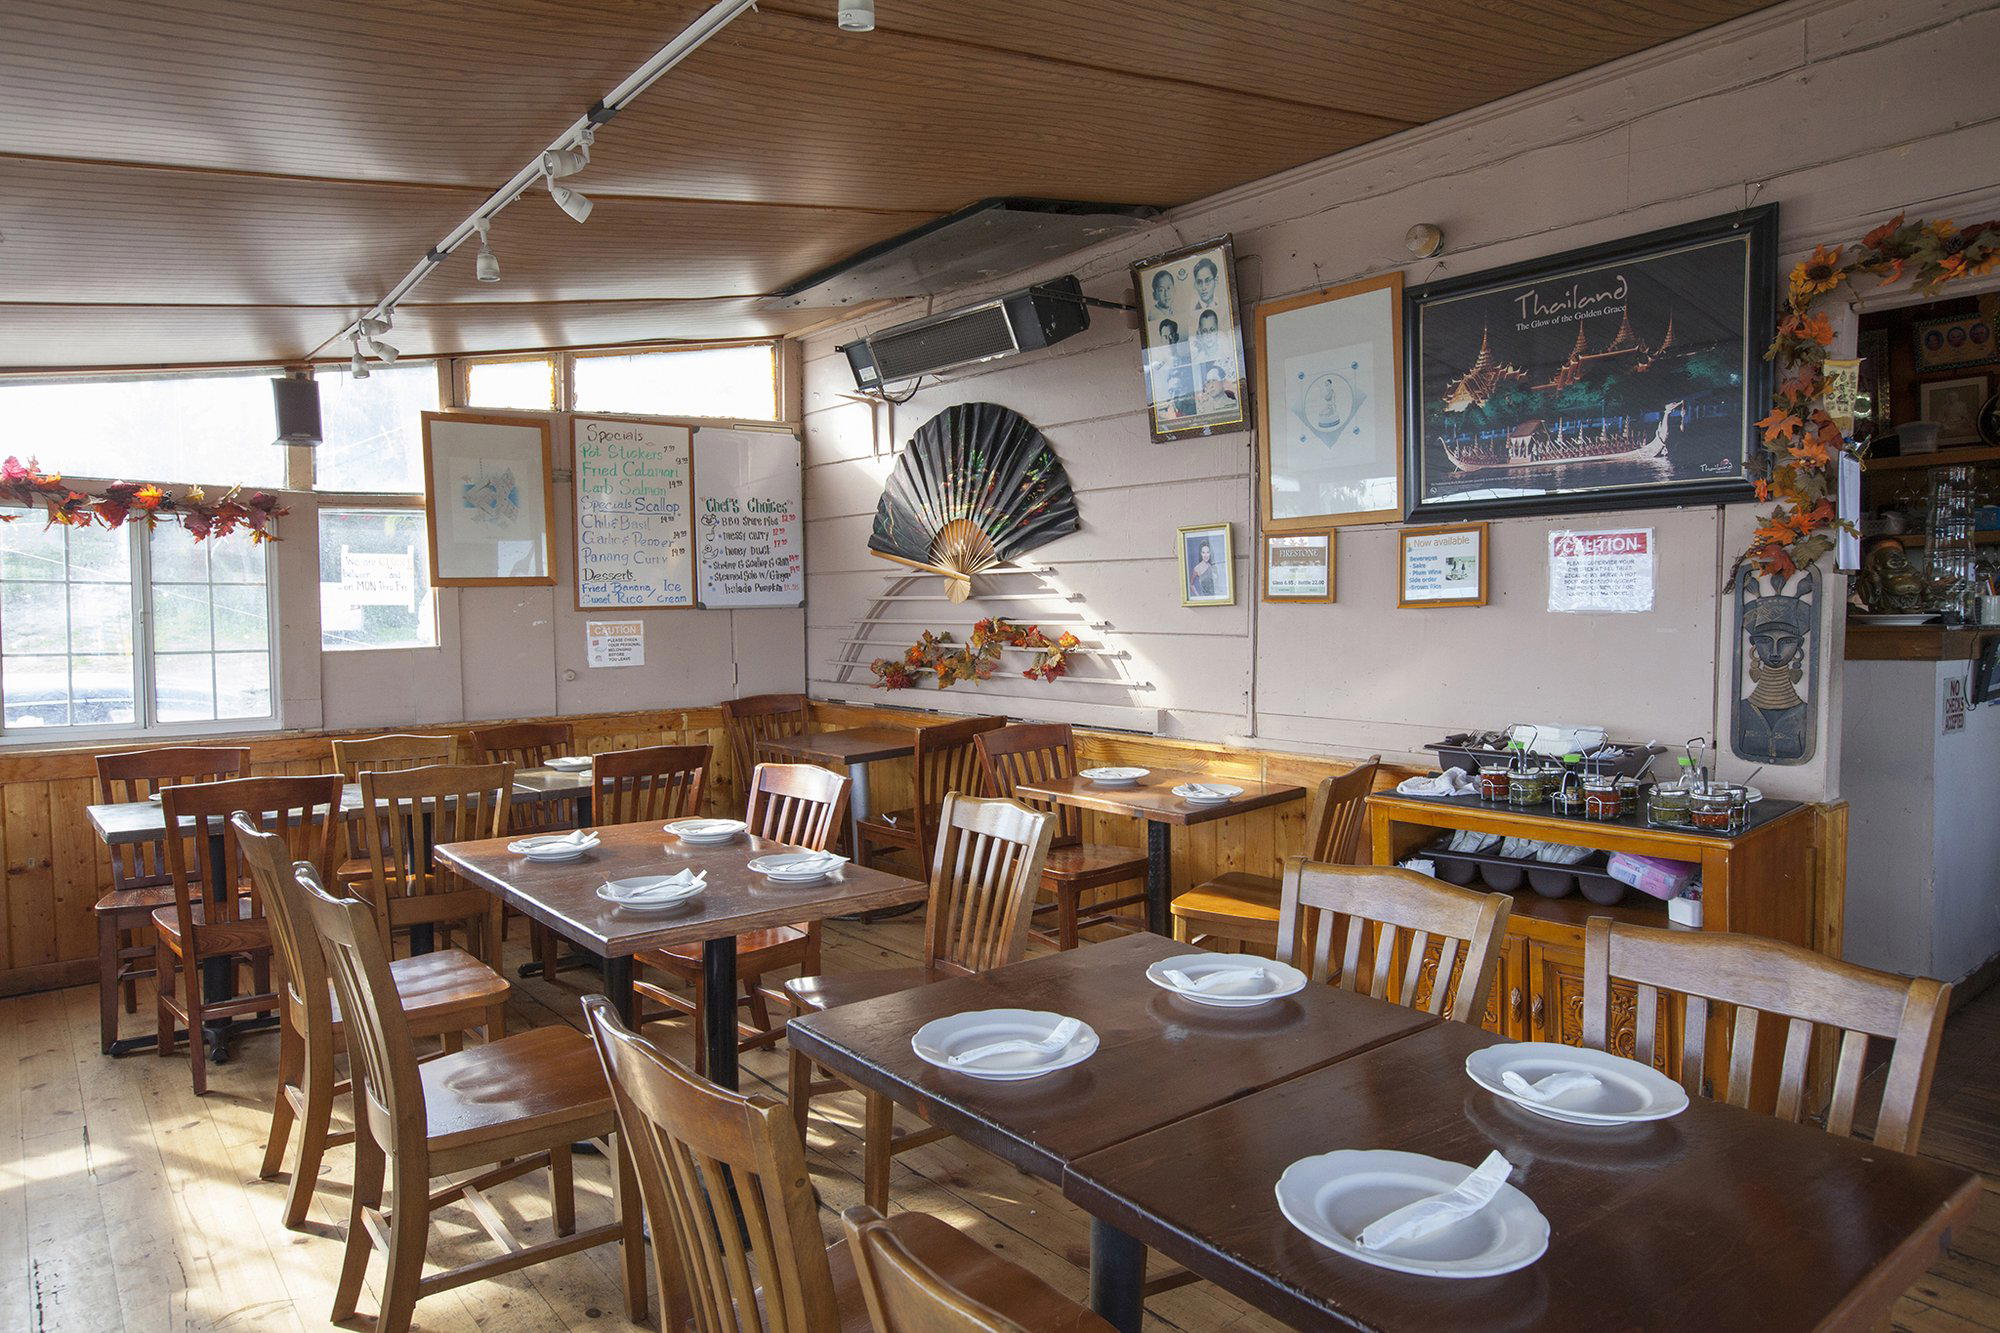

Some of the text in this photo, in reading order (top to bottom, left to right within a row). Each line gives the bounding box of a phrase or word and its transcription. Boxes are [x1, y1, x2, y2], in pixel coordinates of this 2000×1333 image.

[1514, 275, 1628, 320] Thailand
[1516, 305, 1626, 331] The Glow of the Golden Grace
[587, 424, 643, 443] Specials
[580, 442, 601, 458] Pot
[608, 444, 663, 460] Stickers
[582, 461, 618, 477] Fried
[622, 461, 679, 478] Calamari
[1700, 462, 1733, 472] Thailand
[582, 478, 614, 495] Larb
[619, 479, 667, 496] Salmon
[635, 497, 680, 515] Scallop
[582, 530, 620, 545] Garlic
[1414, 536, 1470, 548] Now available
[633, 550, 668, 565] Curry
[1280, 549, 1320, 557] FIRESTONE
[582, 583, 607, 594] Fried
[663, 579, 682, 592] Ice
[615, 591, 644, 604] Rice
[594, 625, 638, 635] CAUTION
[1950, 679, 1960, 697] NO
